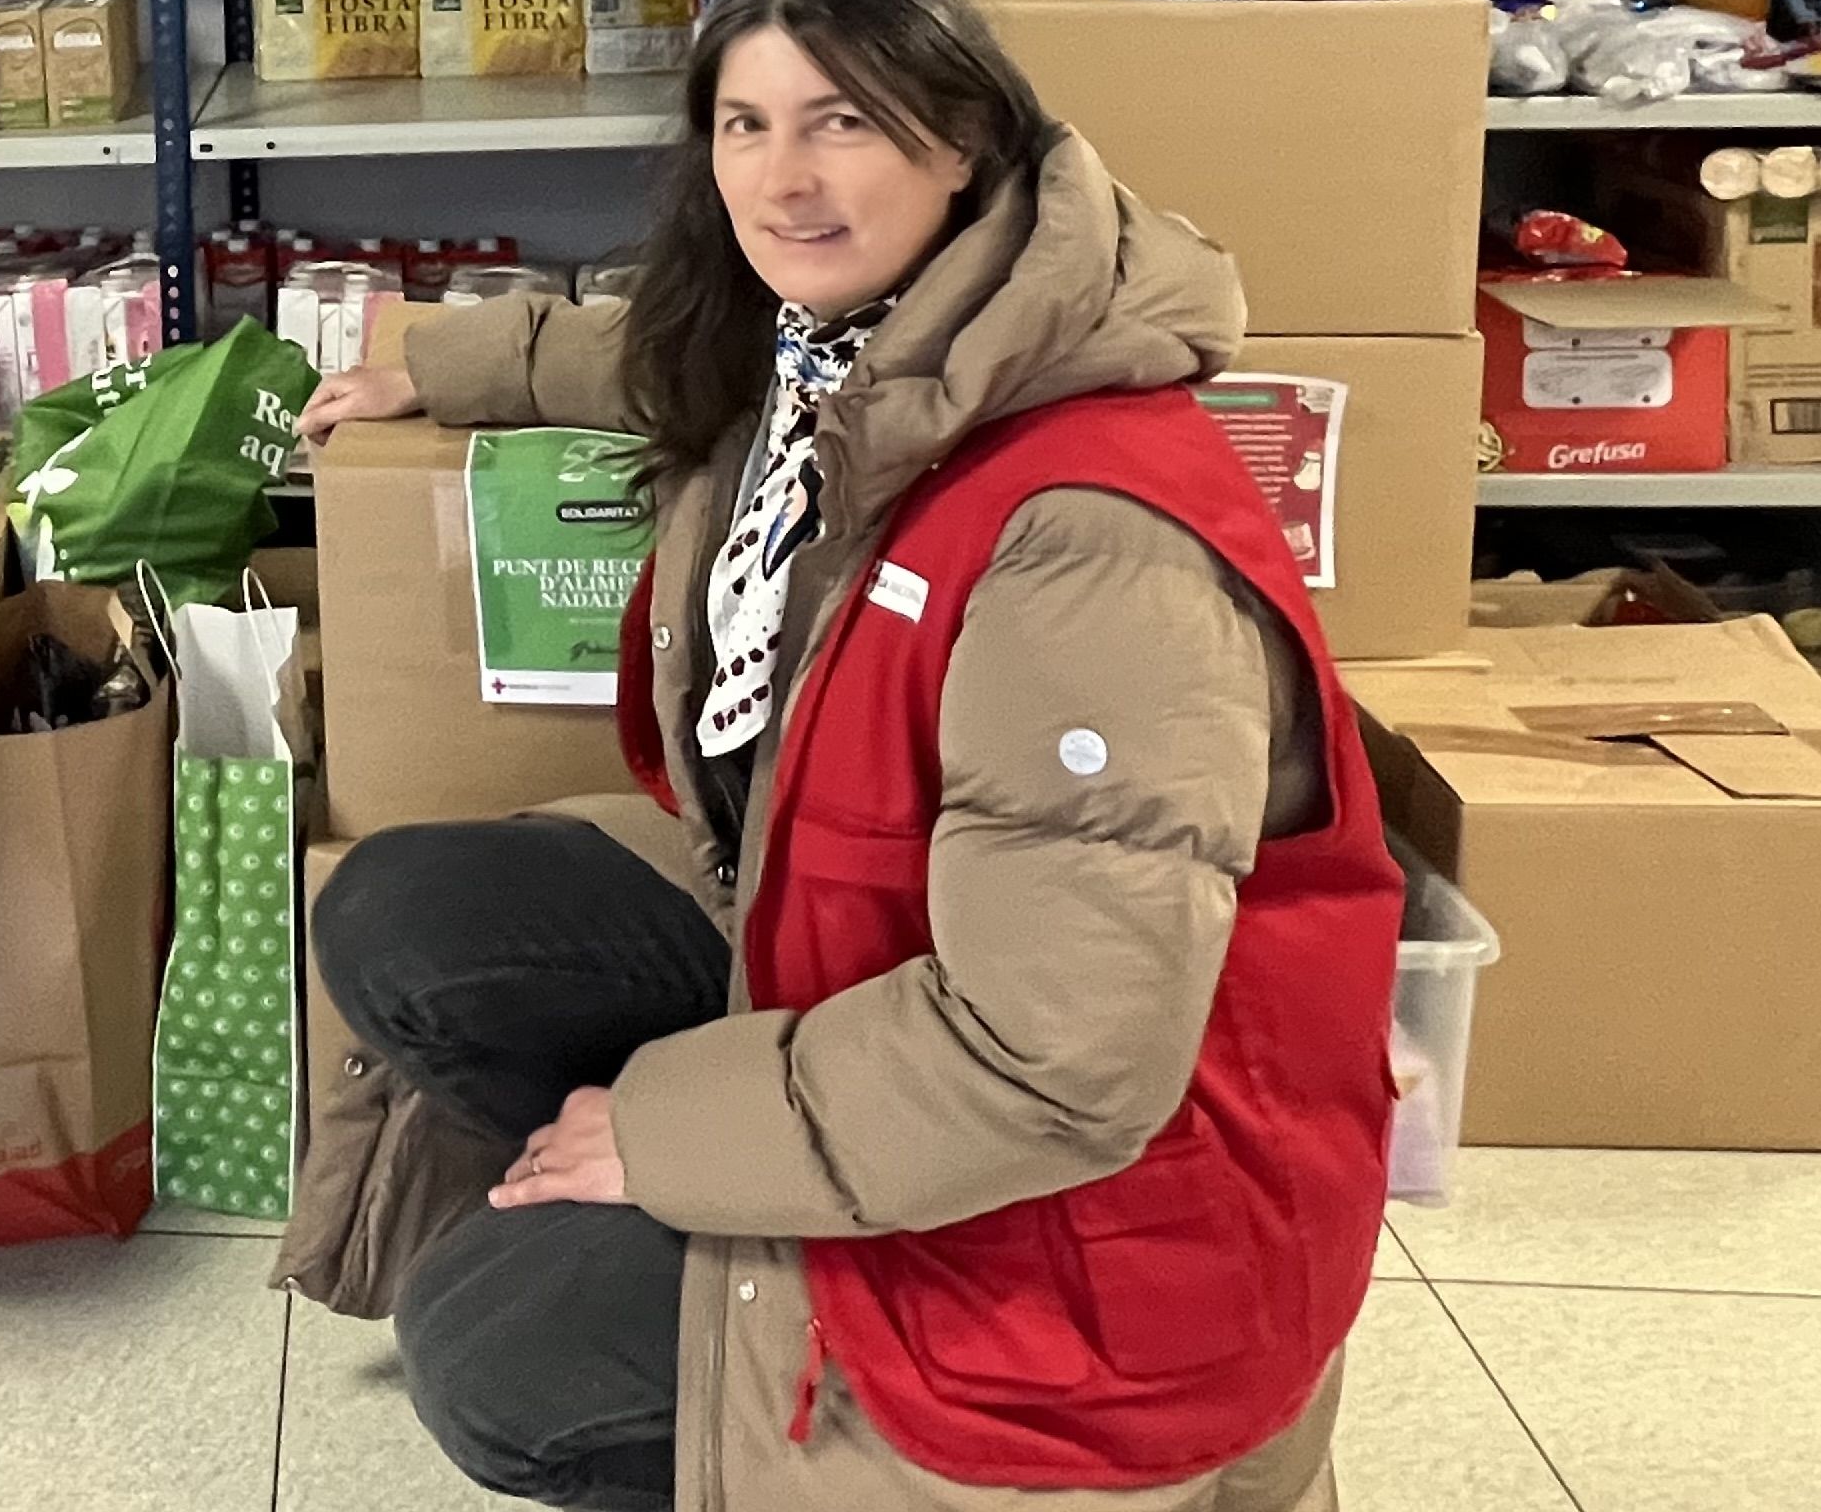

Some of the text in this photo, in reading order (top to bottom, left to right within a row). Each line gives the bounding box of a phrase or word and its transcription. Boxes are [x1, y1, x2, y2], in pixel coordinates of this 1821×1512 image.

[326, 13, 408, 36] FIBRA
[483, 11, 568, 32] FIBRA
[1547, 439, 1647, 470] Grefusa
[493, 558, 549, 577] PUNT
